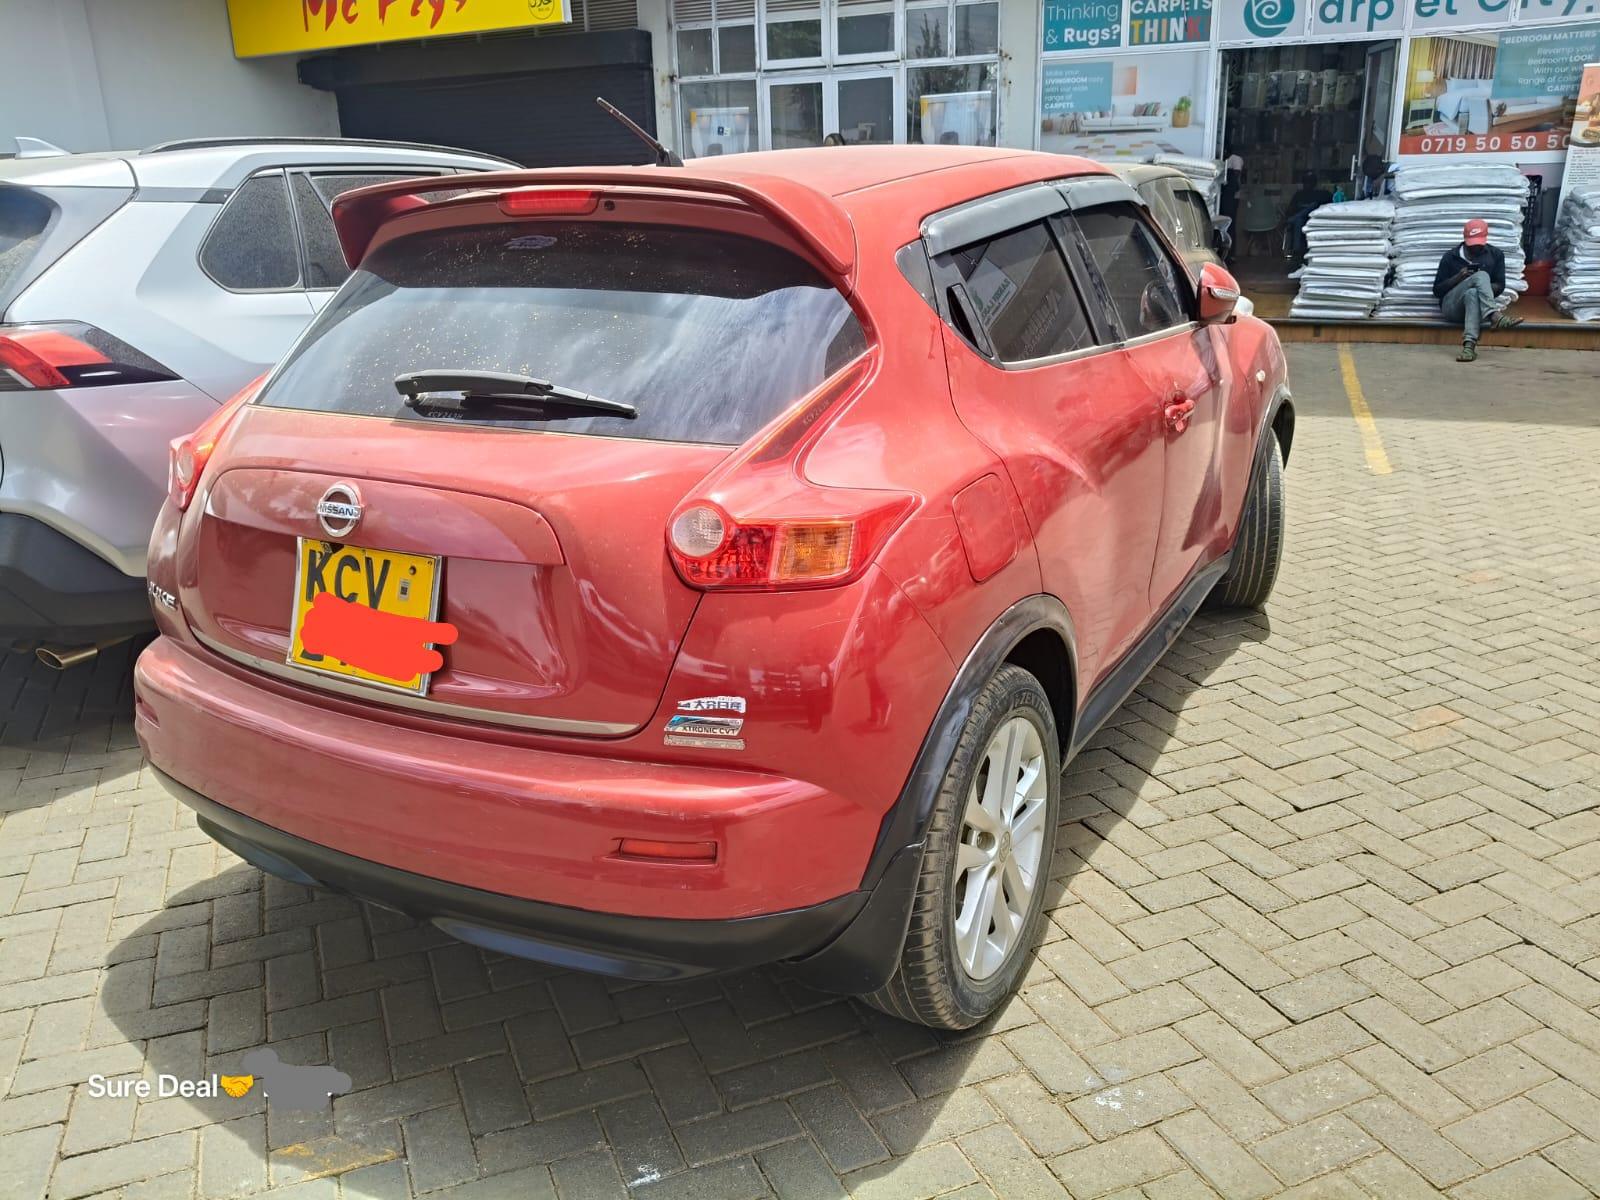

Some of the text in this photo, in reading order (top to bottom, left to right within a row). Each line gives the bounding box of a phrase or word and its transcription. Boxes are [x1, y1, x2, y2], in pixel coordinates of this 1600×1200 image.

[1047, 3, 1119, 21] Thinking
[1046, 24, 1121, 46] & Rugs?
[1421, 137, 1466, 152] 0719
[1476, 136, 1500, 151] 50
[1511, 135, 1537, 149] 50
[320, 503, 354, 516] NISSAN
[306, 549, 391, 610] KCV
